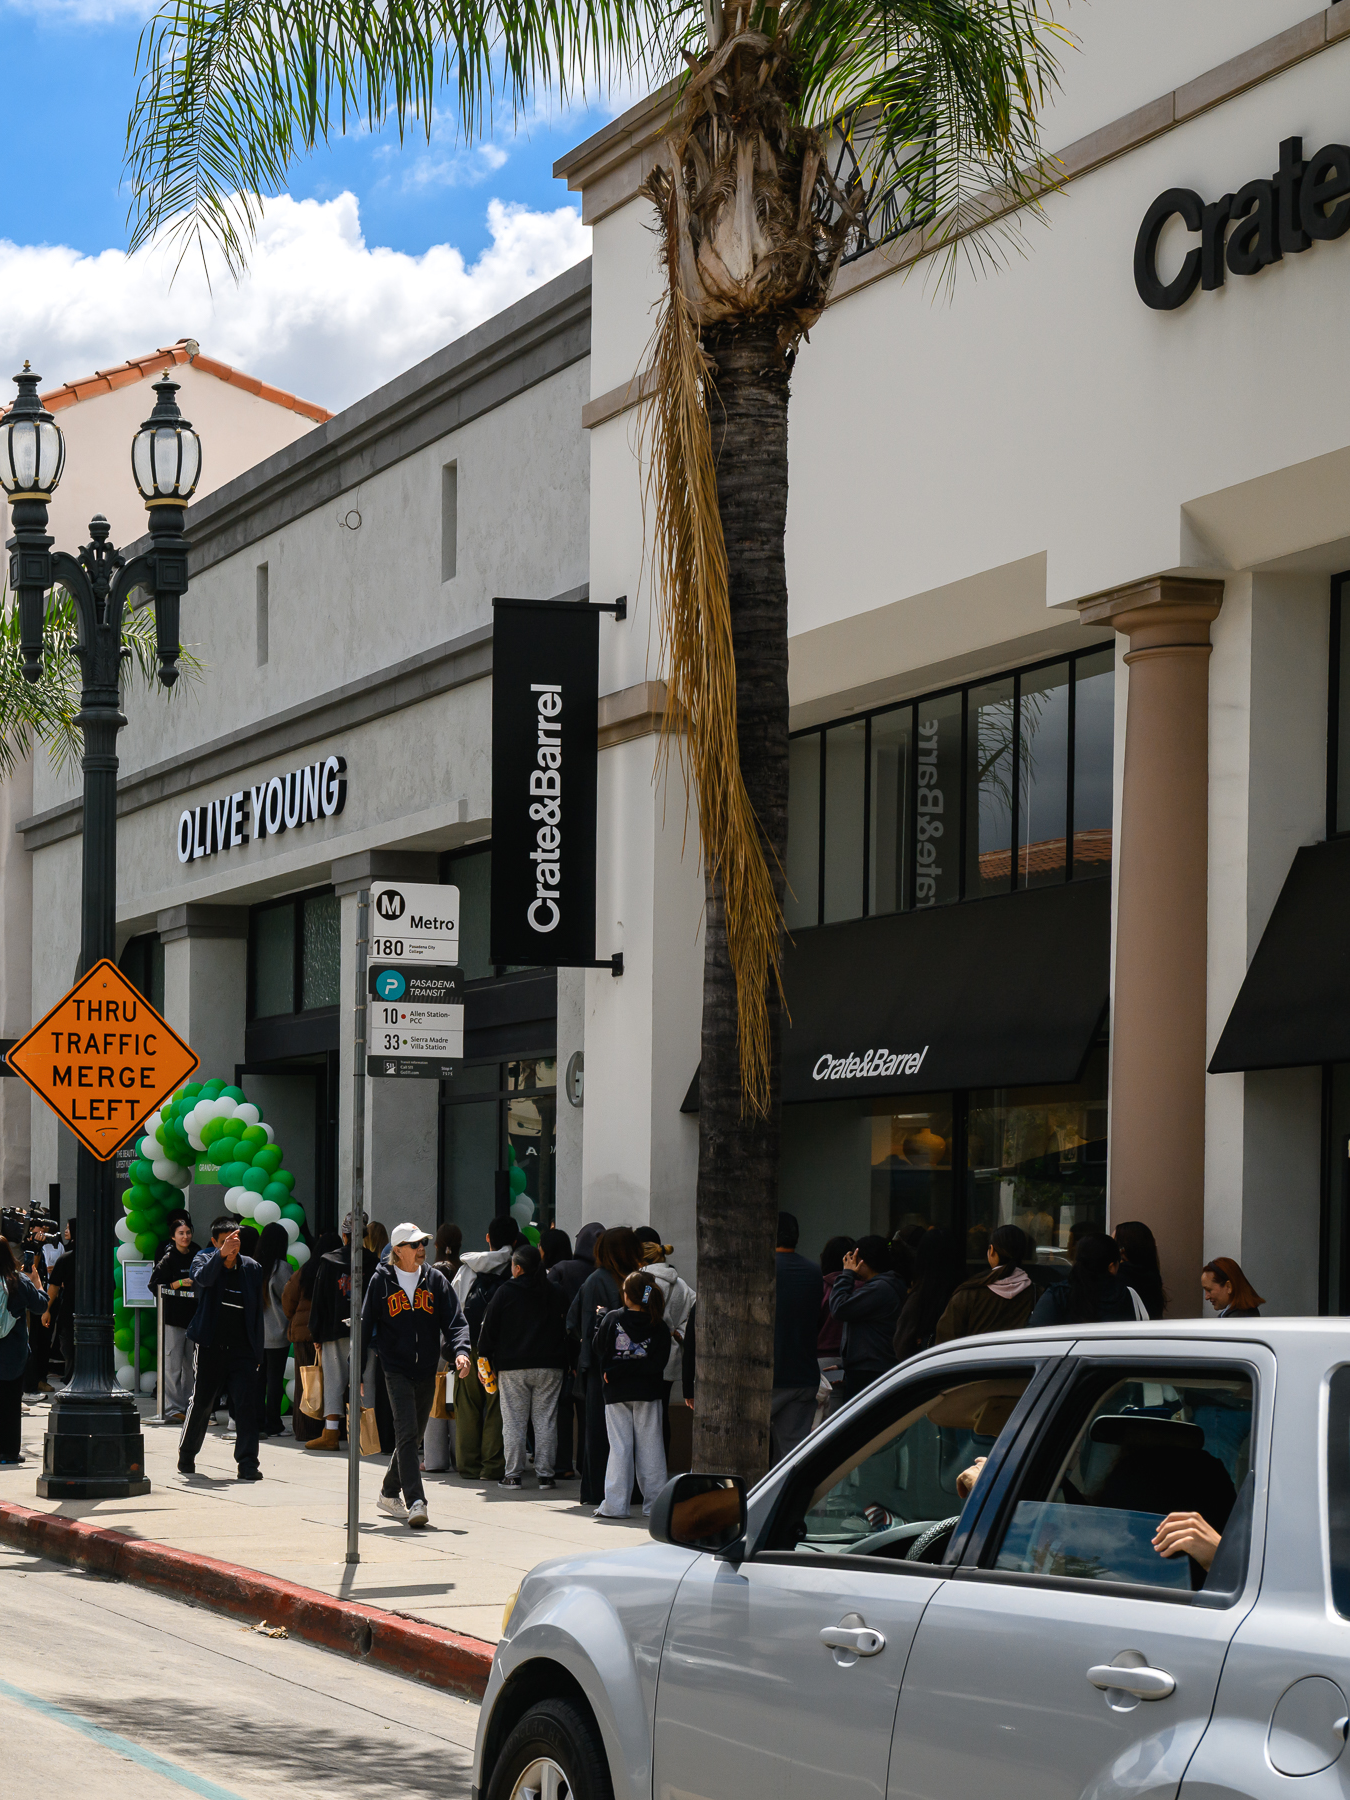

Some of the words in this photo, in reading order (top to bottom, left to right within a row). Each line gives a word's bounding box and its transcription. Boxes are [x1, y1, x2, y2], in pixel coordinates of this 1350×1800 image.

[1133, 136, 1350, 310] Crate
[177, 790, 250, 863] OLIVE
[250, 755, 347, 839] YOUNG
[527, 683, 562, 933] Crate&Barrel
[410, 915, 455, 931] Metro
[374, 938, 404, 956] 180
[410, 979, 456, 989] PASADENA
[410, 988, 446, 997] TRANSIT
[72, 999, 137, 1022] THRU
[383, 1008, 398, 1025] 10
[409, 1010, 426, 1018] Allen
[427, 1011, 451, 1019] Station-
[51, 1032, 157, 1056] TRAFFIC
[384, 1033, 400, 1050] 33
[425, 1043, 447, 1051] Station
[812, 1046, 929, 1080] Crate&Barrel
[52, 1065, 156, 1089] MERGE
[72, 1098, 140, 1121] LEFT
[199, 1164, 212, 1172] GRAND
